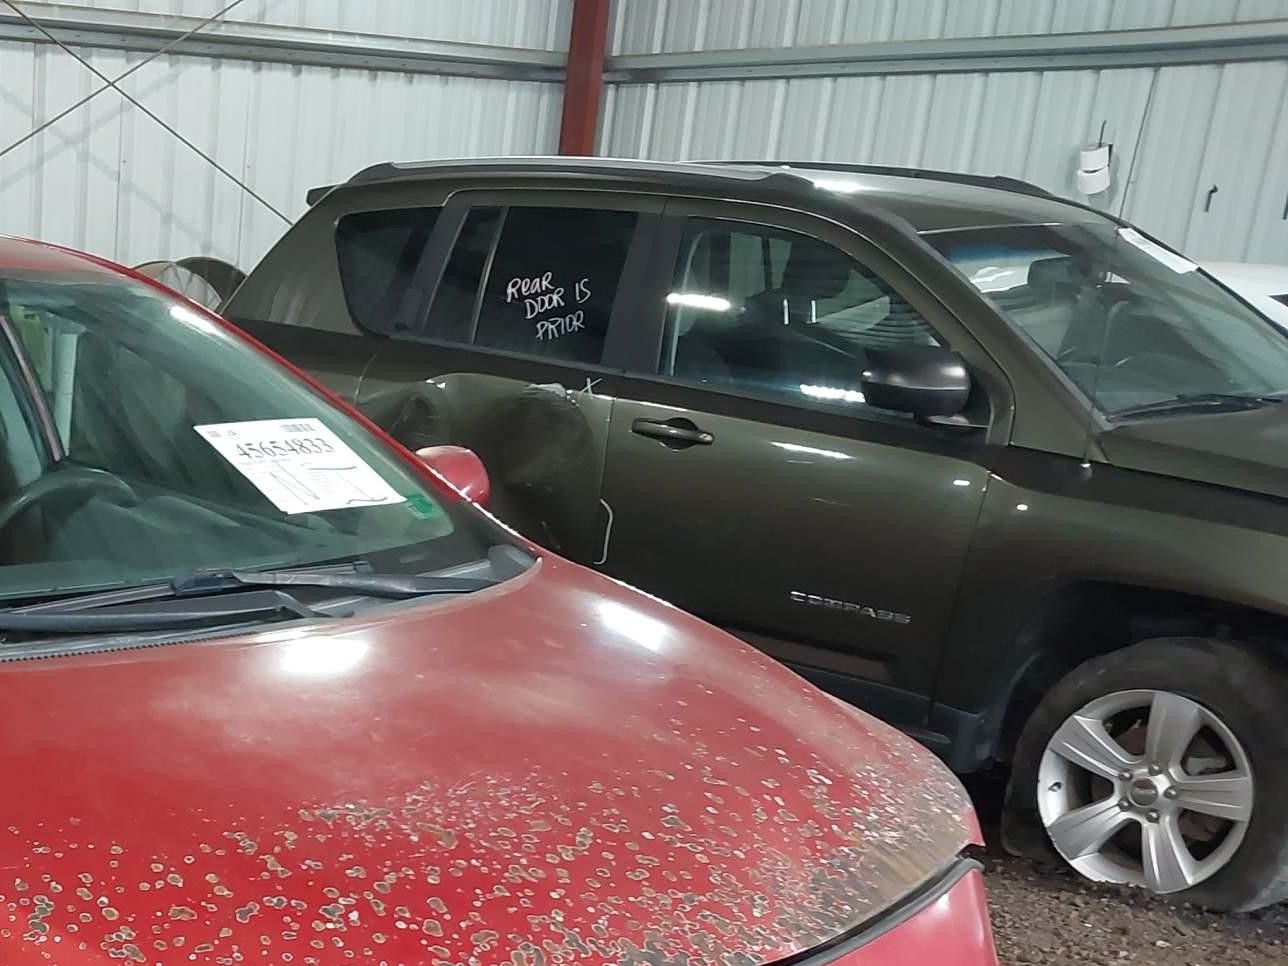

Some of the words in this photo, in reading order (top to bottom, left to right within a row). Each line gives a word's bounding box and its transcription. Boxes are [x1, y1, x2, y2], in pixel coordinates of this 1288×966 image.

[523, 287, 566, 320] DOOR
[574, 278, 592, 304] IS
[535, 310, 585, 341] PRIOR
[236, 437, 336, 460] 45654833
